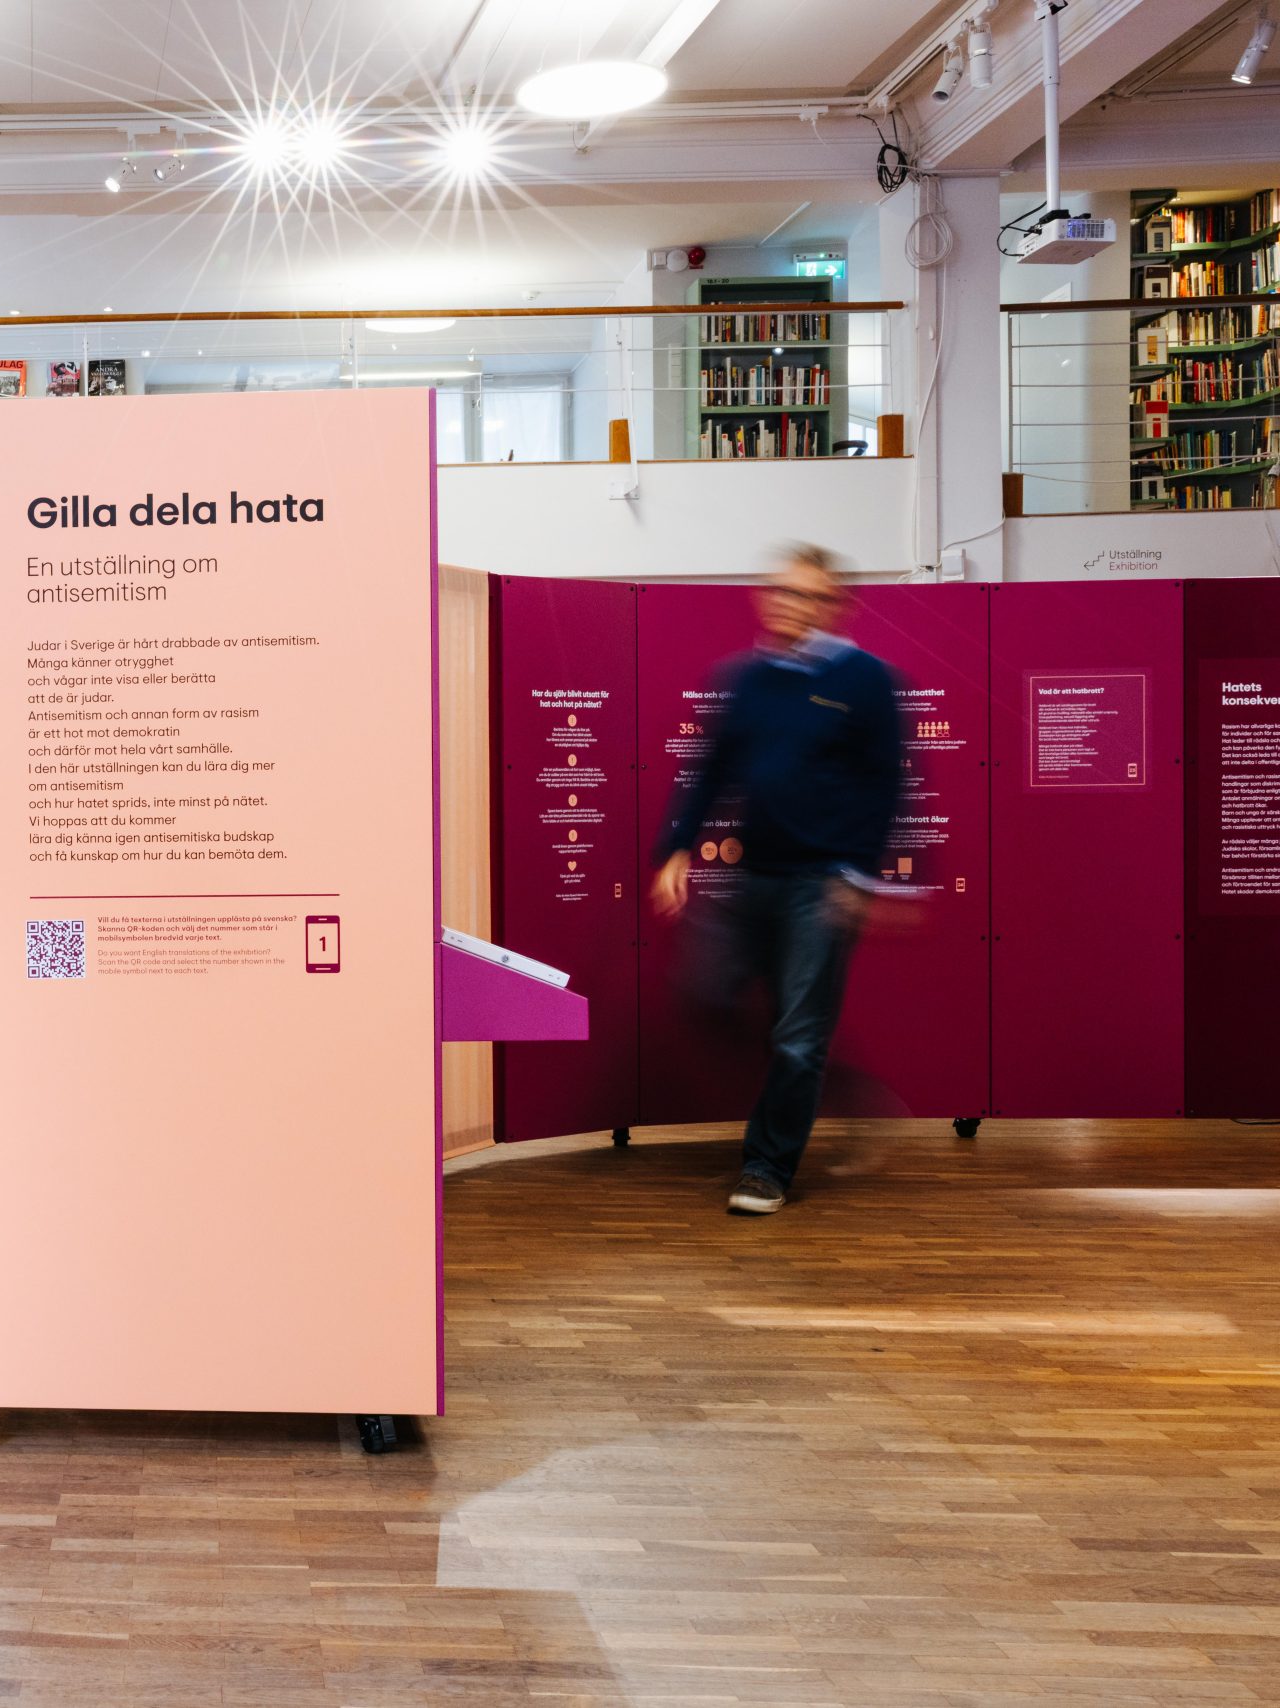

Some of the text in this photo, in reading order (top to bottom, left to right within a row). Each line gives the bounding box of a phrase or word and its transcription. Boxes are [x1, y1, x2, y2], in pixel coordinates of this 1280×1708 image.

[27, 492, 324, 528] Gilla dela hata
[1109, 549, 1162, 560] Utställning
[27, 555, 218, 579] En utställning om
[1109, 562, 1158, 571] Exhibition
[27, 582, 167, 603] antisemitism
[27, 640, 62, 651] Judar
[70, 640, 115, 653] Sverige
[117, 639, 130, 650] är
[133, 638, 159, 649] hårt
[161, 637, 221, 648] drabbade
[223, 639, 238, 647] av
[241, 636, 320, 647] antisemitism.
[27, 656, 174, 671] Många känner otrygghet
[27, 673, 216, 688] och vågar inte visa eller berätta
[682, 690, 703, 698] Hälsa
[907, 689, 945, 697] utsatthet
[1222, 682, 1262, 693] Hatets
[27, 692, 114, 706] att de är judar.
[552, 690, 567, 699] själv
[567, 690, 582, 698] blivit
[600, 690, 610, 698] för
[540, 700, 551, 708] hat
[551, 700, 563, 708] och
[563, 700, 574, 708] hot
[574, 700, 583, 709] på
[28, 708, 259, 721] Antisemitism och annan form av rasism
[28, 726, 180, 739] är ett hot mot demokratin
[679, 723, 695, 735] 35
[28, 743, 233, 757] och därför mot hela vårt samhälle.
[34, 763, 57, 774] den
[60, 763, 80, 774] här
[83, 762, 159, 775] utställningen
[162, 761, 183, 772] kan
[186, 761, 201, 772] du
[204, 761, 228, 772] lära
[230, 760, 249, 774] dig
[252, 762, 276, 771] mer
[28, 780, 124, 792] om antisemitism
[28, 796, 268, 810] och hur hatet sprids, inte minst på nätet.
[29, 815, 177, 829] Vi hoppas att du kommer
[930, 815, 950, 823] ökar
[29, 831, 275, 847] lära dig känna igen antisemitiska budskap
[29, 848, 287, 863] och få kunskap om hur du kan bemöta dem.
[167, 916, 216, 924] utställningen
[217, 916, 251, 924] upplästa
[126, 925, 165, 933] QR-koden
[181, 925, 195, 933] välj
[319, 936, 326, 952] 1
